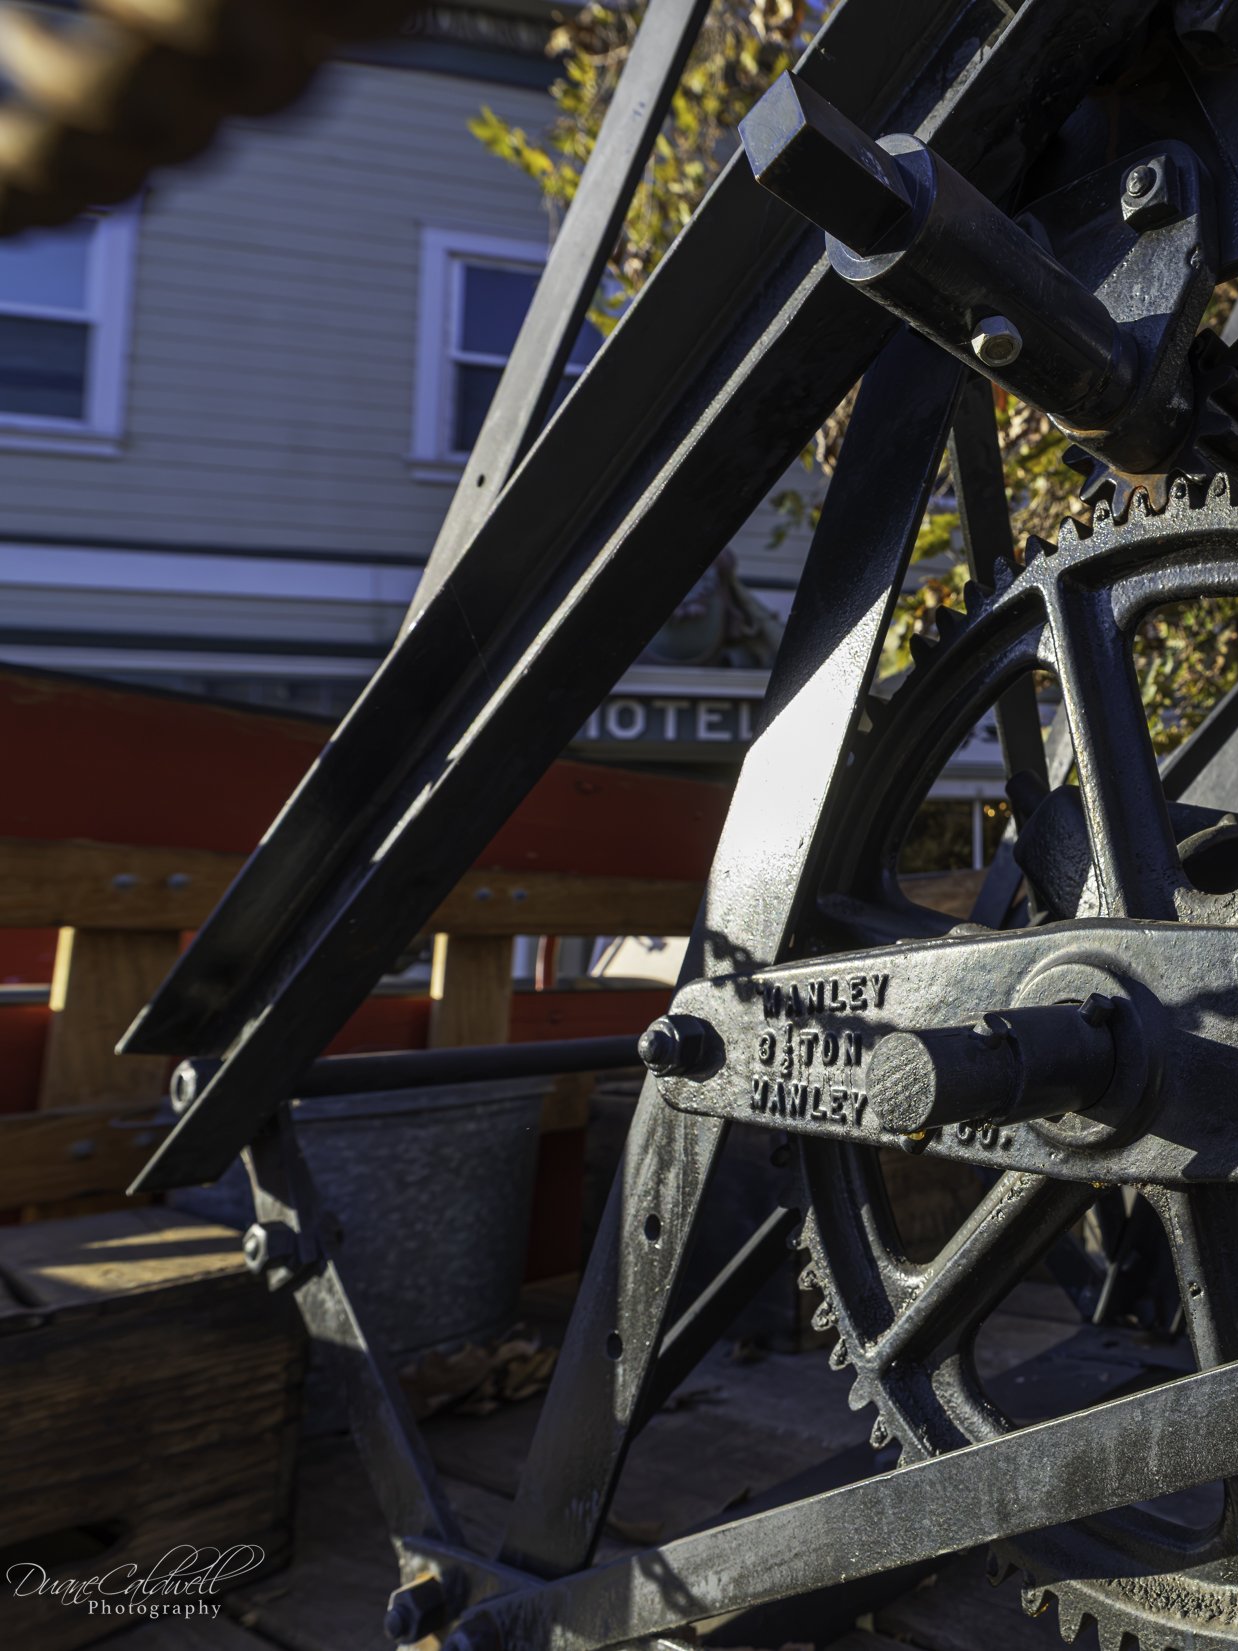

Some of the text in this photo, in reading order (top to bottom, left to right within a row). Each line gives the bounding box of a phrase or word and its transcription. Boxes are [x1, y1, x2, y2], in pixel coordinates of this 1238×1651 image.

[762, 973, 889, 1018] MANLEY
[799, 1031, 863, 1067] TON
[750, 1073, 868, 1126] MANLEY
